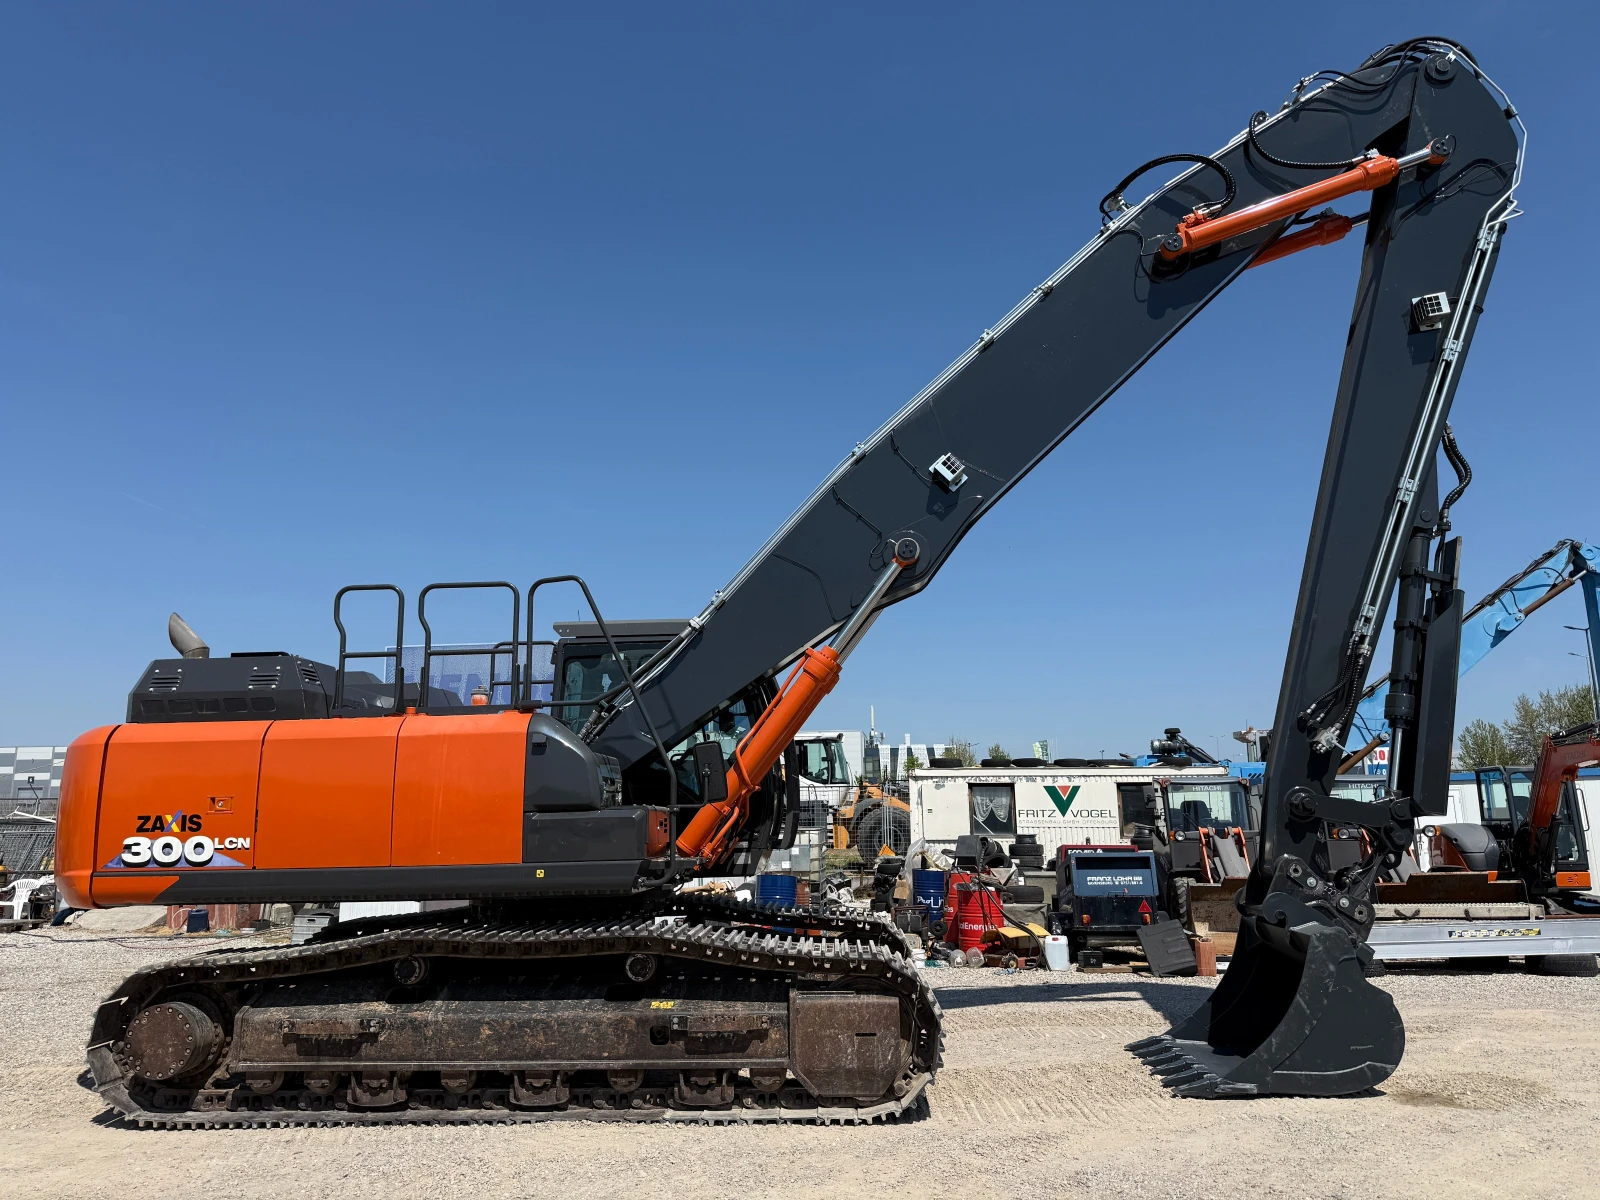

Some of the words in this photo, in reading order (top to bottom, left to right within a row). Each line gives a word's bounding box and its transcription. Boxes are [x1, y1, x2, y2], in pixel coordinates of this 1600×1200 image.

[136, 810, 203, 833] ZAXIS
[1018, 809, 1056, 818] FRITZ
[1070, 809, 1117, 818] VOGEL
